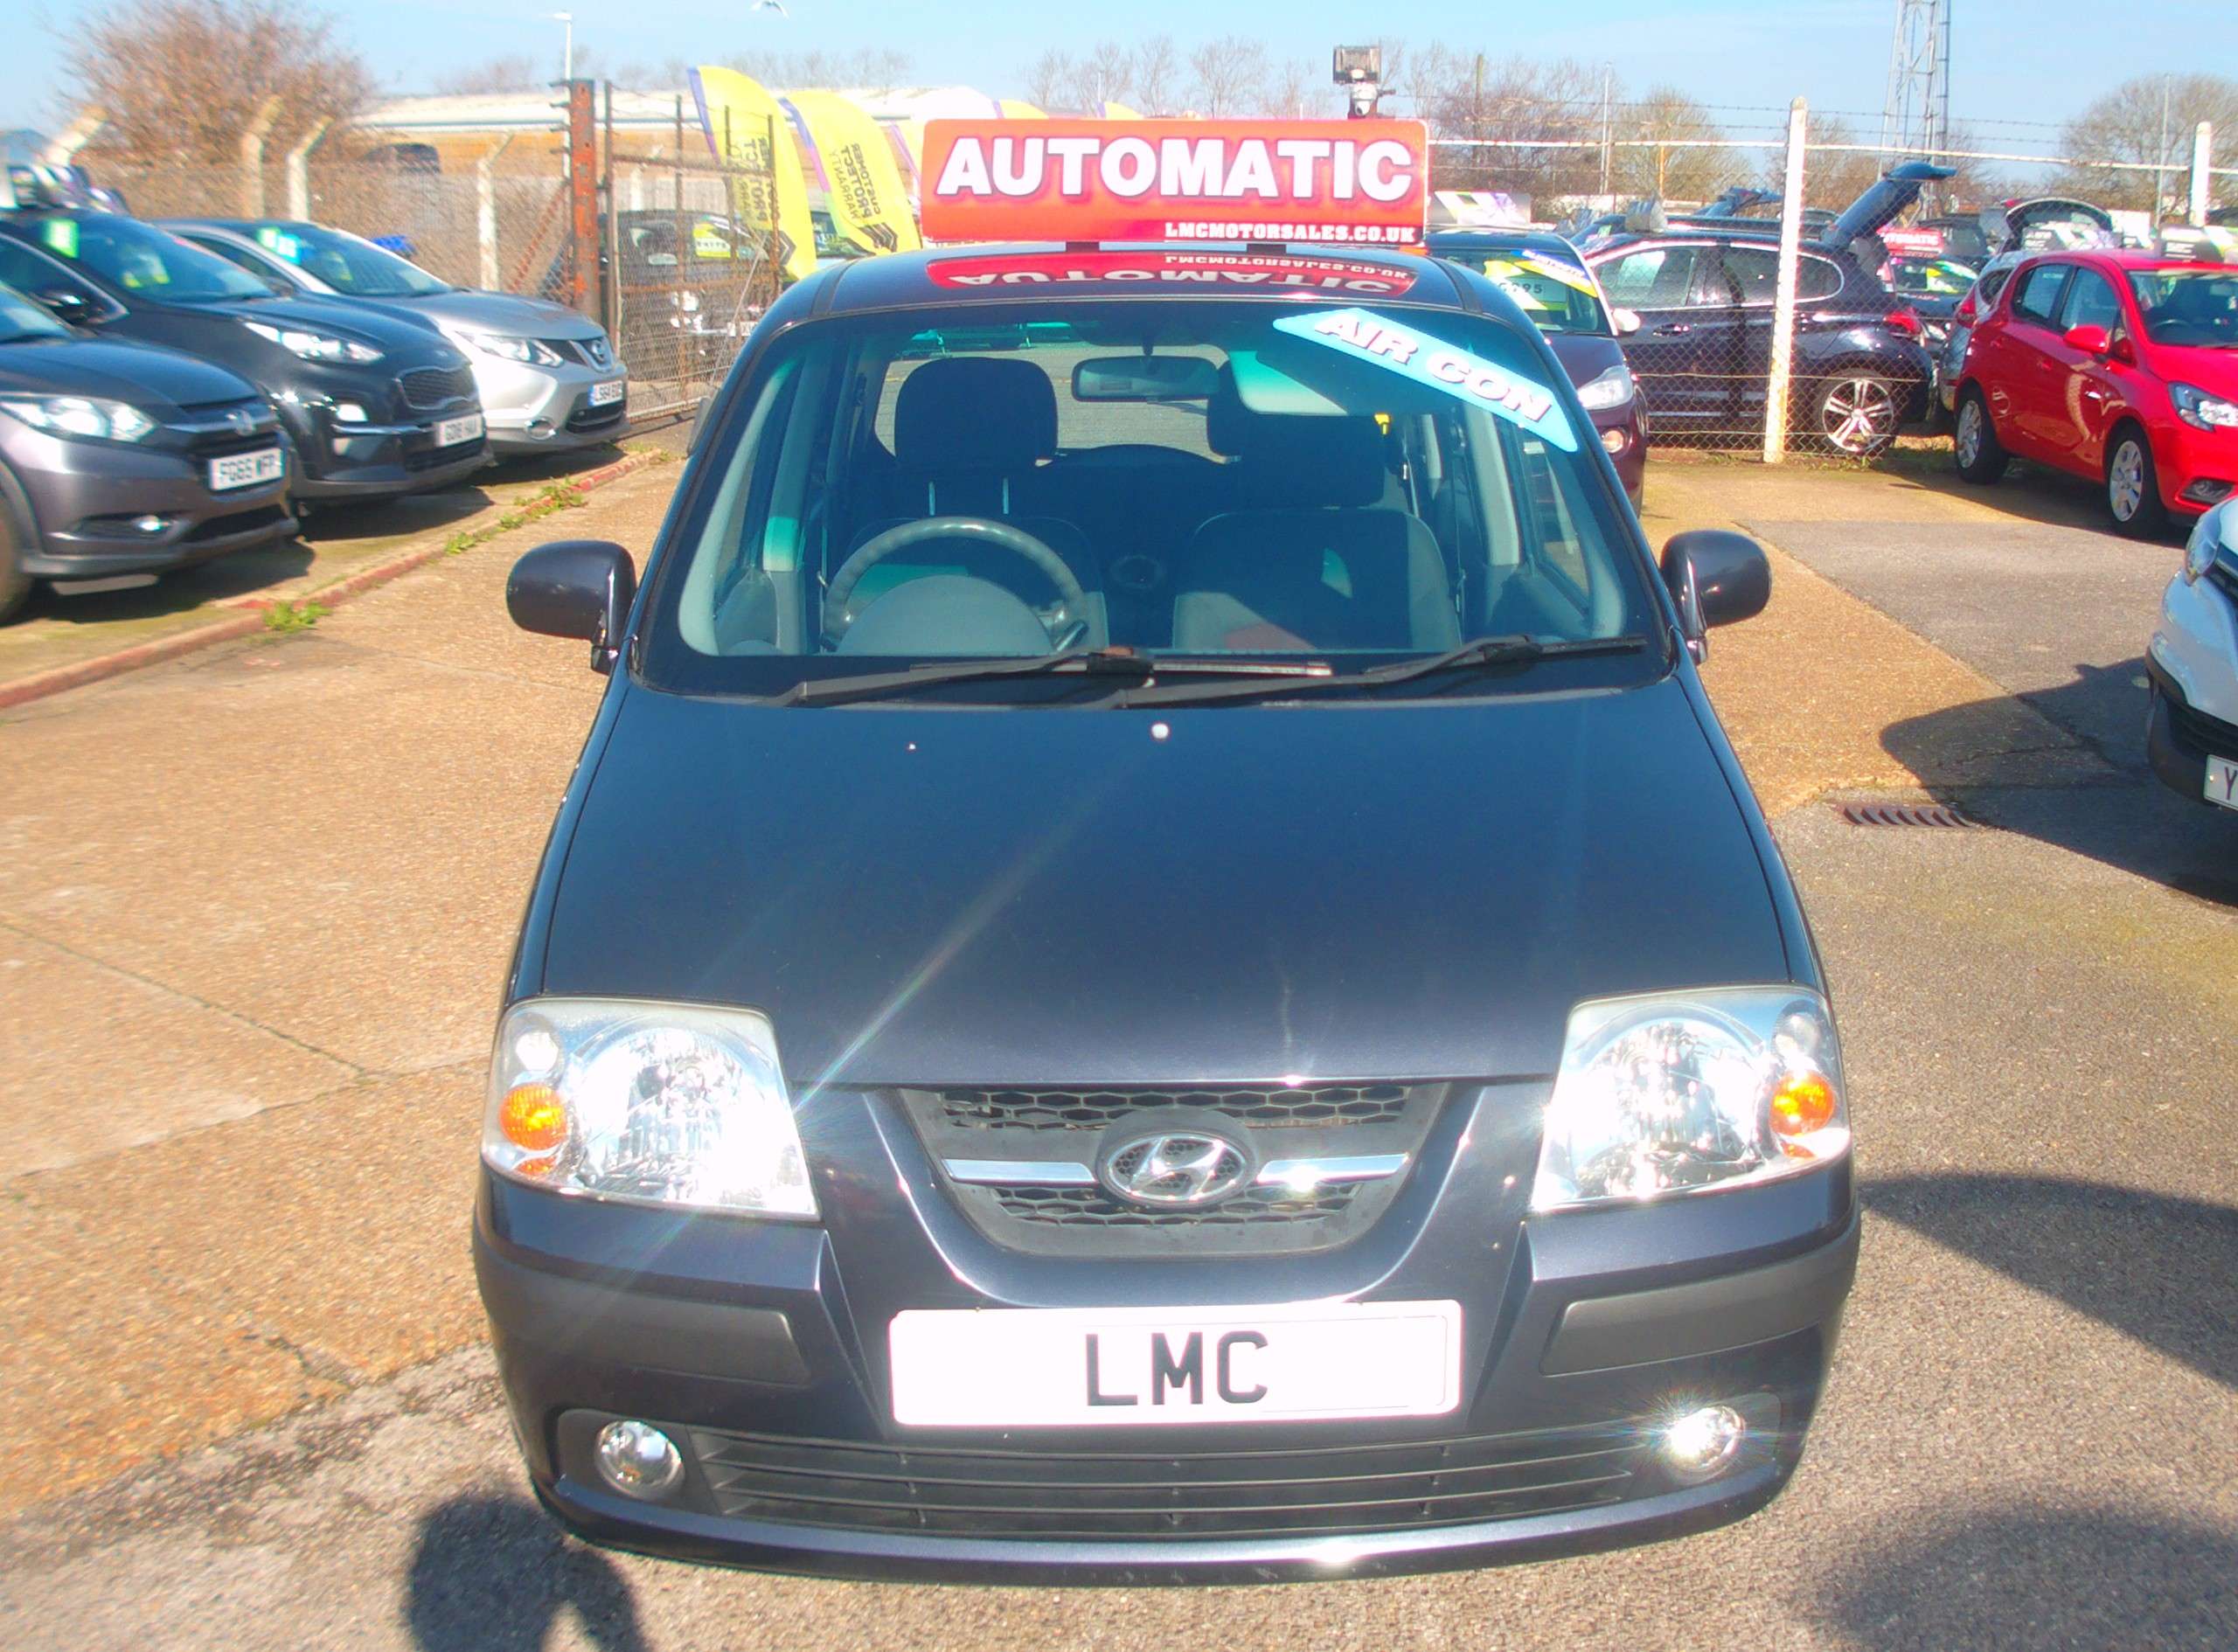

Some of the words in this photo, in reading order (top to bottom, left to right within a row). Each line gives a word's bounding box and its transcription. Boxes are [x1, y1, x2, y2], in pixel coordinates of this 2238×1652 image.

[936, 138, 1412, 201] AUTOMATIC
[1164, 221, 1415, 244] LMCMOTORSALES.CO.UK
[1315, 311, 1419, 365] AIR
[1426, 350, 1553, 423] CON
[1086, 1330, 1268, 1406] LMC
